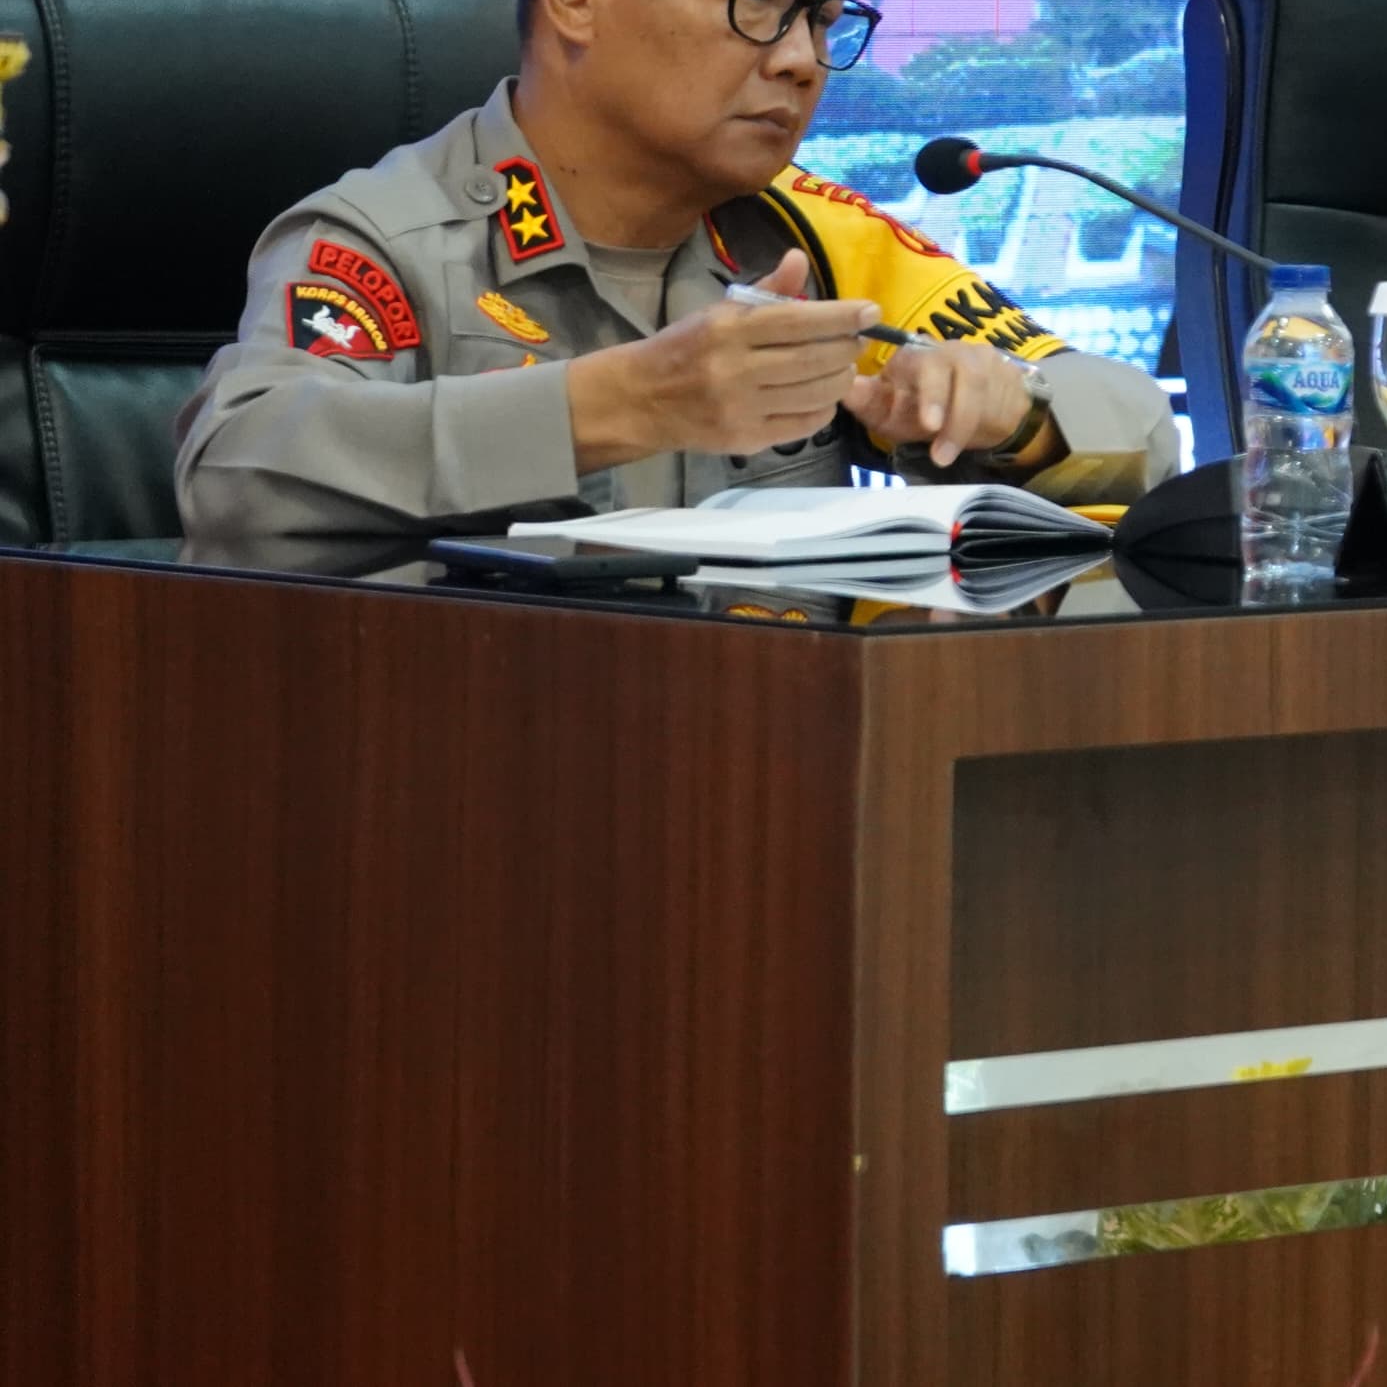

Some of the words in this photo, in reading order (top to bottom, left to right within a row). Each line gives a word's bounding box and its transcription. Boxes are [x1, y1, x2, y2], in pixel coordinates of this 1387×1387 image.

[296, 285, 348, 308] KORPS
[319, 245, 413, 341] PELOPOR
[1293, 371, 1340, 392] AQUA
